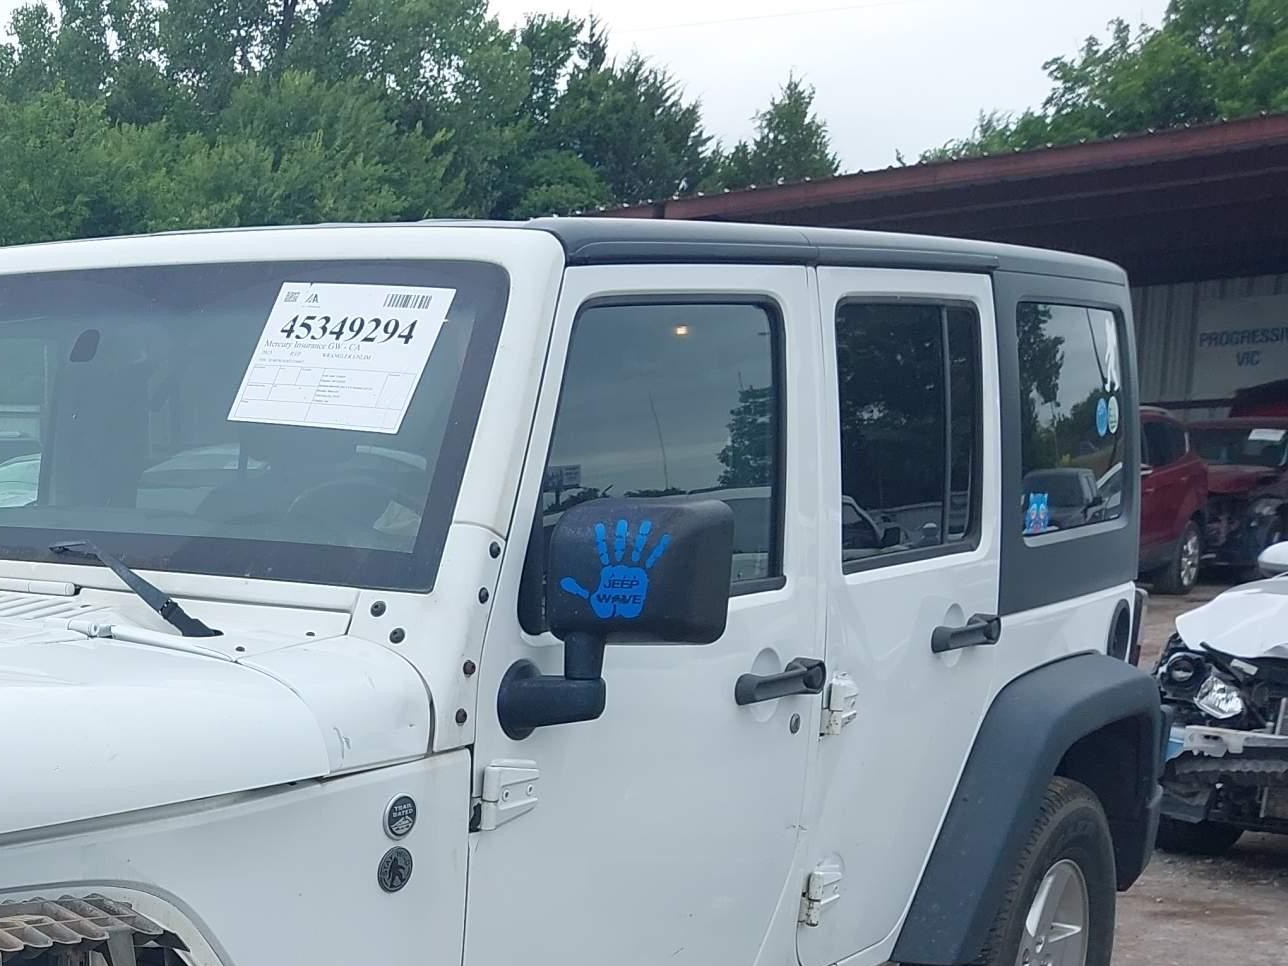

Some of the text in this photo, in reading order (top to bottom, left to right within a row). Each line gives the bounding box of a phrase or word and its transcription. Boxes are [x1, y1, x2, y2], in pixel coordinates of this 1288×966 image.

[280, 314, 418, 344] 45349294
[264, 338, 292, 350] Mercury
[294, 341, 325, 350] Insurance
[1236, 350, 1260, 367] VIC
[603, 578, 640, 588] JEEP
[596, 594, 642, 605] WAVE
